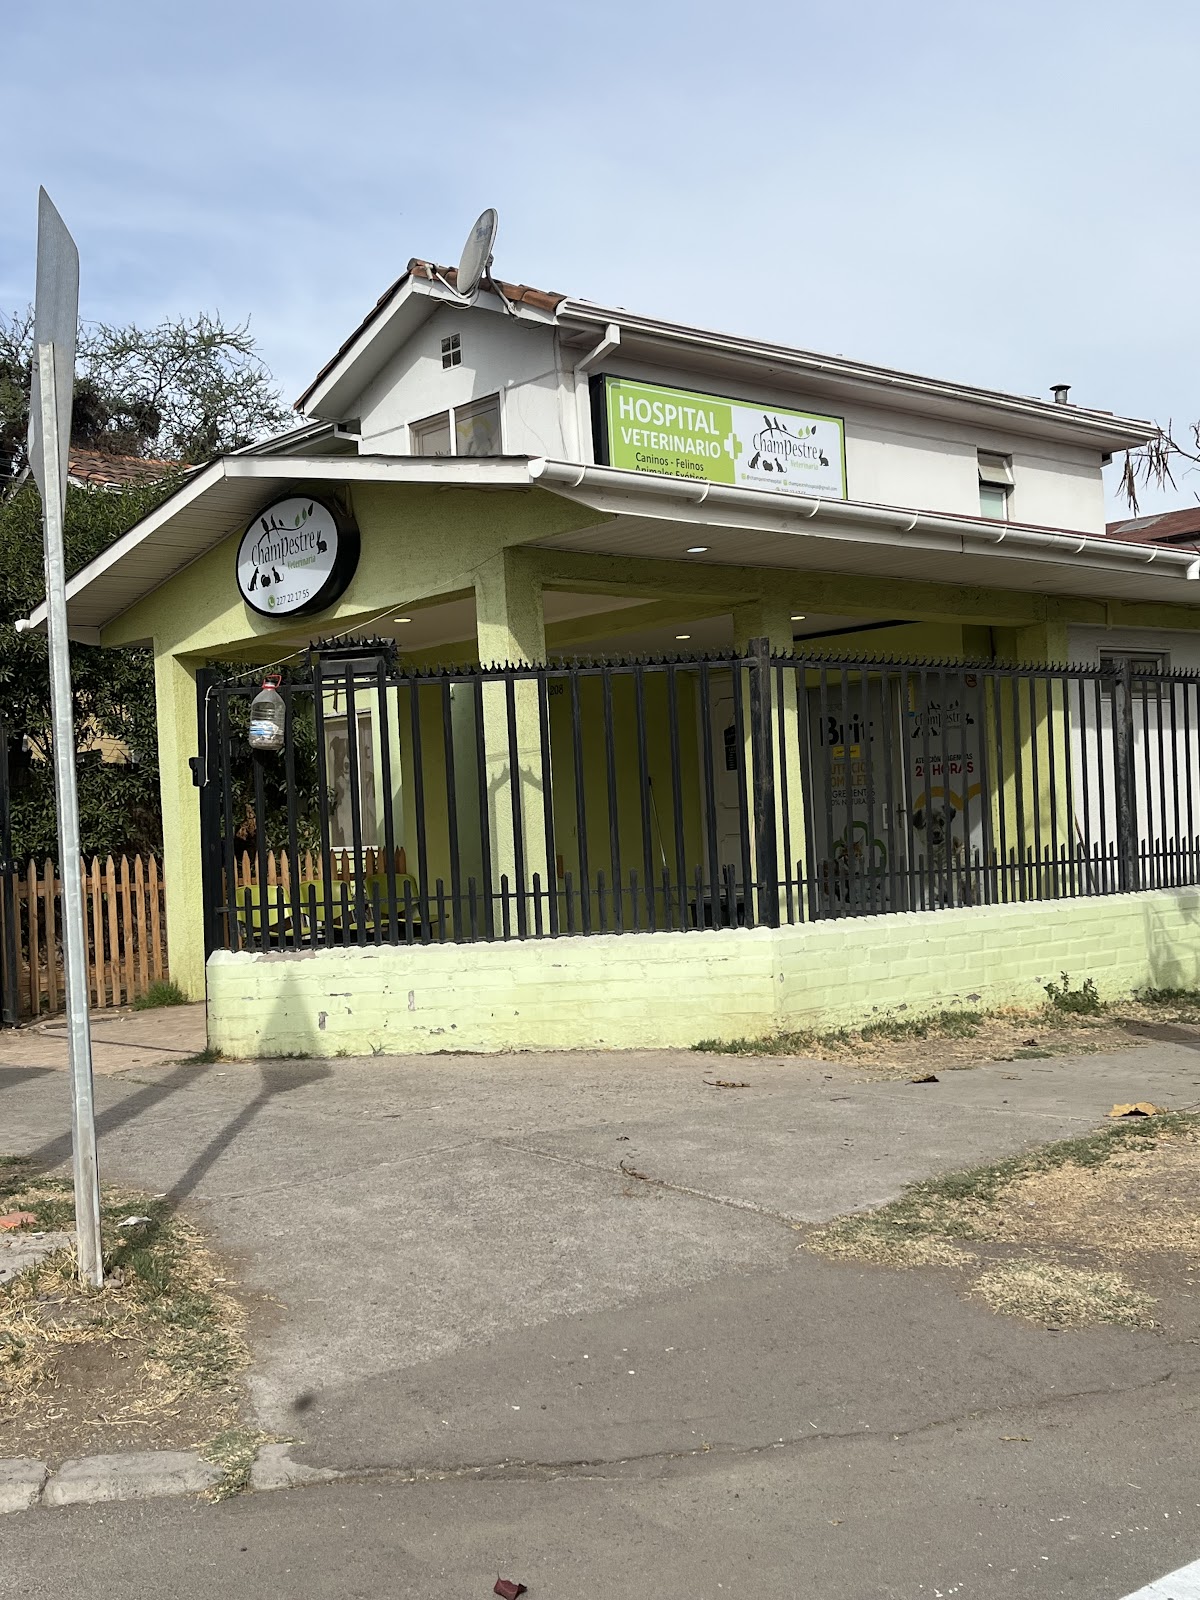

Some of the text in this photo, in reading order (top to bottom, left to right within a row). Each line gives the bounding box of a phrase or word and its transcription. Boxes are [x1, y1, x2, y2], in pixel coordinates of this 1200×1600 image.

[619, 395, 720, 435] HOSPITAL
[620, 426, 721, 459] VETERINARIO
[752, 432, 818, 461] Champestre
[635, 452, 669, 466] Caninos
[676, 458, 704, 472] Felinos
[251, 531, 315, 567] Champestre
[287, 554, 316, 570] Veterinaria
[276, 588, 310, 606] 227 22 17 55
[915, 755, 941, 764] ATECIÓN
